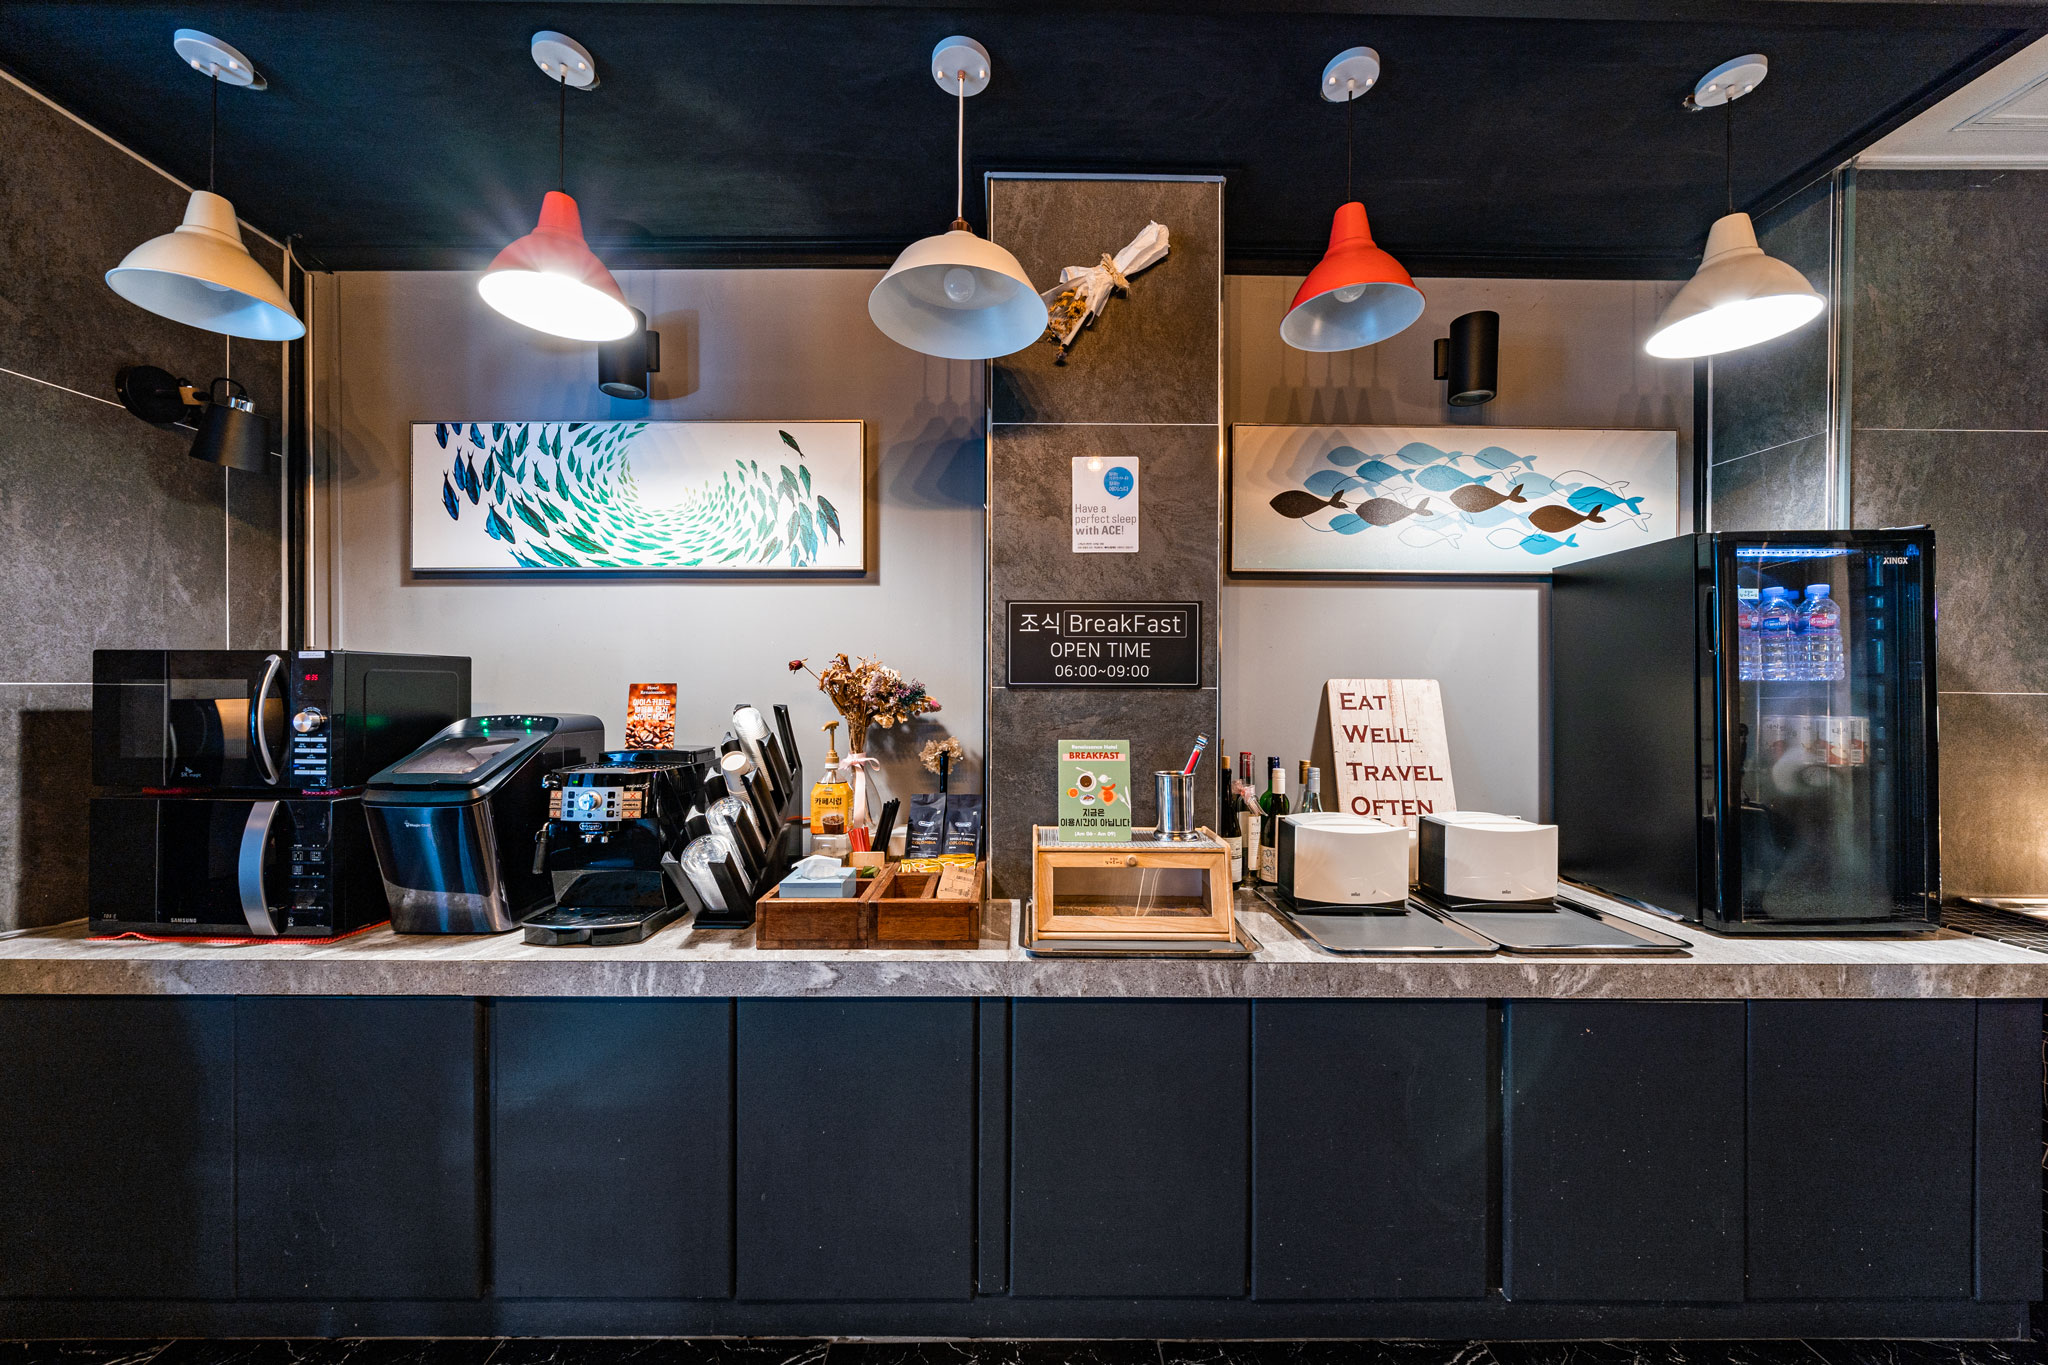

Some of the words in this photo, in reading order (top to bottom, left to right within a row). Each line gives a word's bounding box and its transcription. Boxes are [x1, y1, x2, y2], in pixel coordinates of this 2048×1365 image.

[1075, 504, 1098, 513] Have
[1101, 505, 1106, 513] a
[1075, 514, 1109, 525] perfect
[1112, 514, 1137, 526] sleep
[1076, 526, 1099, 535] with
[1101, 526, 1124, 535] ACE!
[1883, 557, 1908, 565] XINGX
[1019, 612, 1060, 635] 조식
[1070, 614, 1181, 633] BreakFast
[1050, 642, 1100, 658] OPEN
[1107, 642, 1151, 658] TIME
[1055, 665, 1149, 678] 06:00~09:00
[815, 797, 842, 805] 카페시럽
[1083, 808, 1105, 817] 지금은
[1060, 818, 1098, 827] 이용시간이
[1100, 818, 1130, 827] 아닙니다
